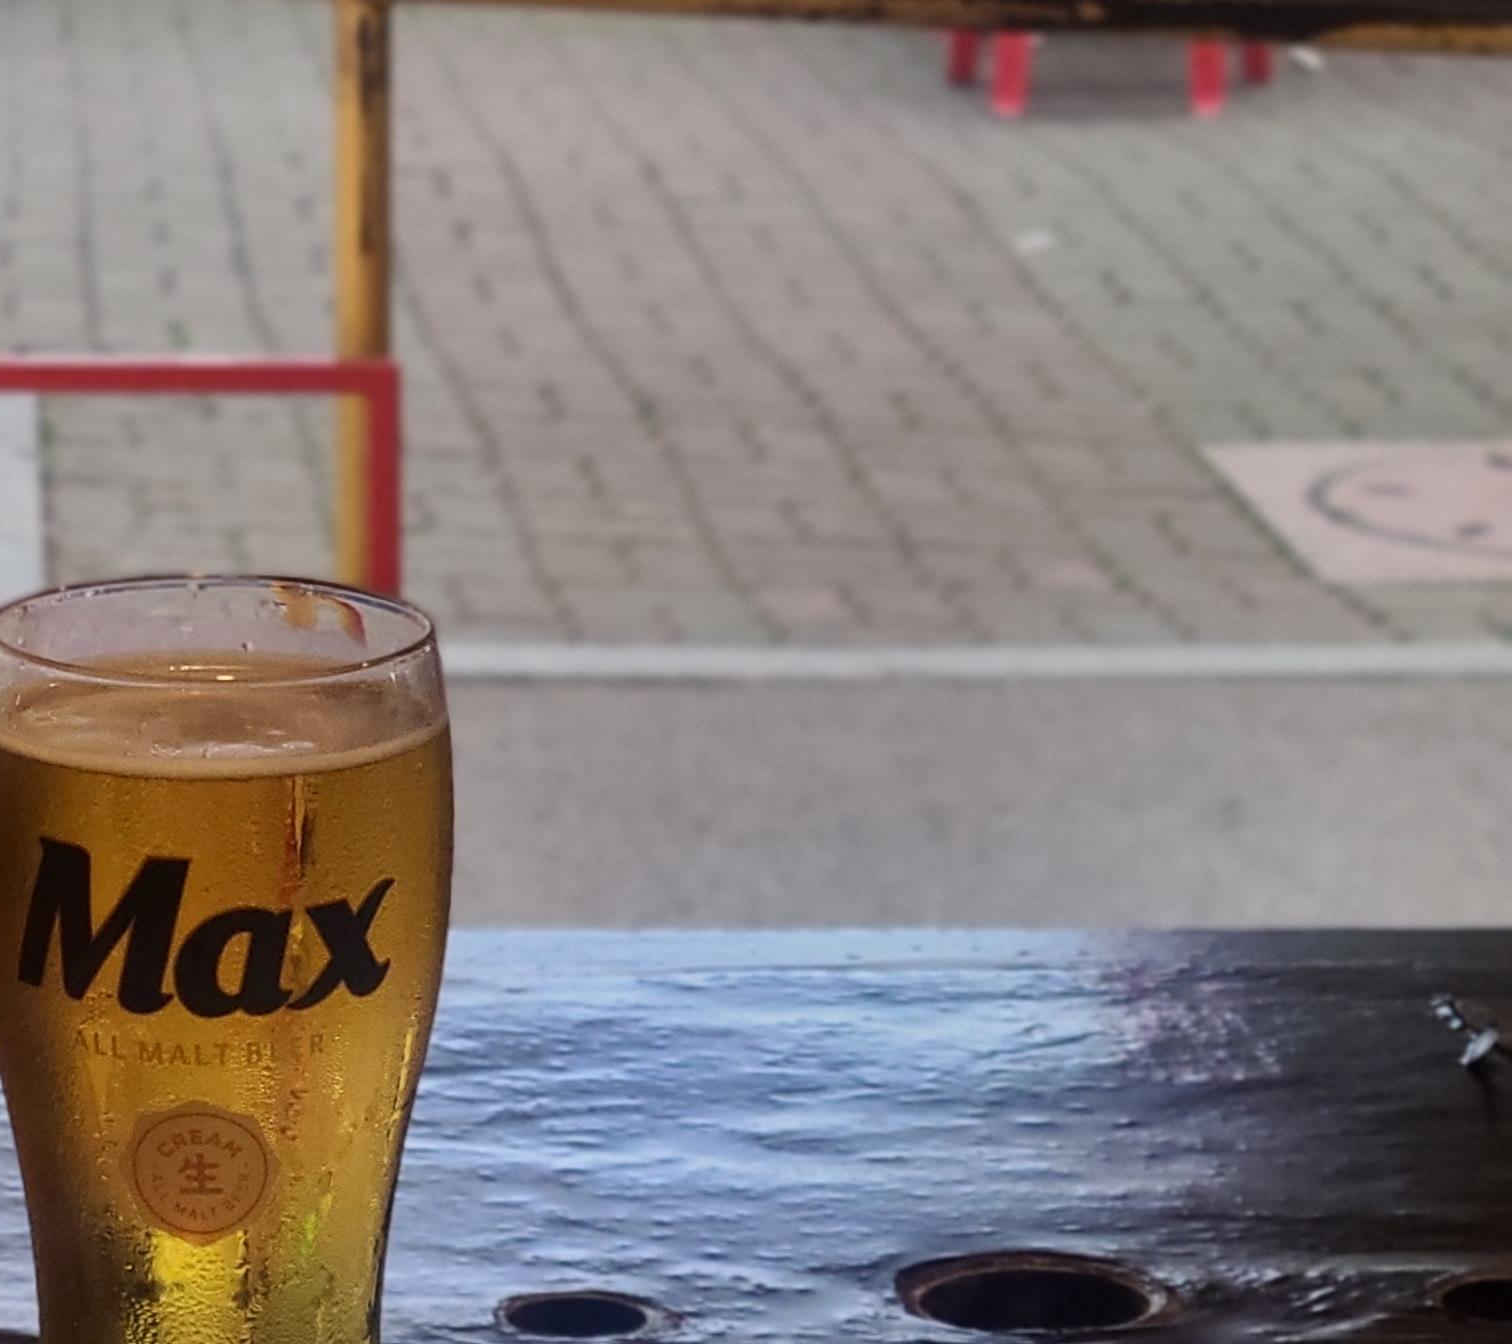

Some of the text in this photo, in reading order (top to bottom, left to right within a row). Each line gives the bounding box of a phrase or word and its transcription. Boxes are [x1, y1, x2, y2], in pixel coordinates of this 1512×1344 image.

[17, 837, 395, 1017] Max
[72, 1031, 324, 1066] ALL MALT BR
[157, 1129, 243, 1159] CREAM
[178, 1152, 223, 1195] 生
